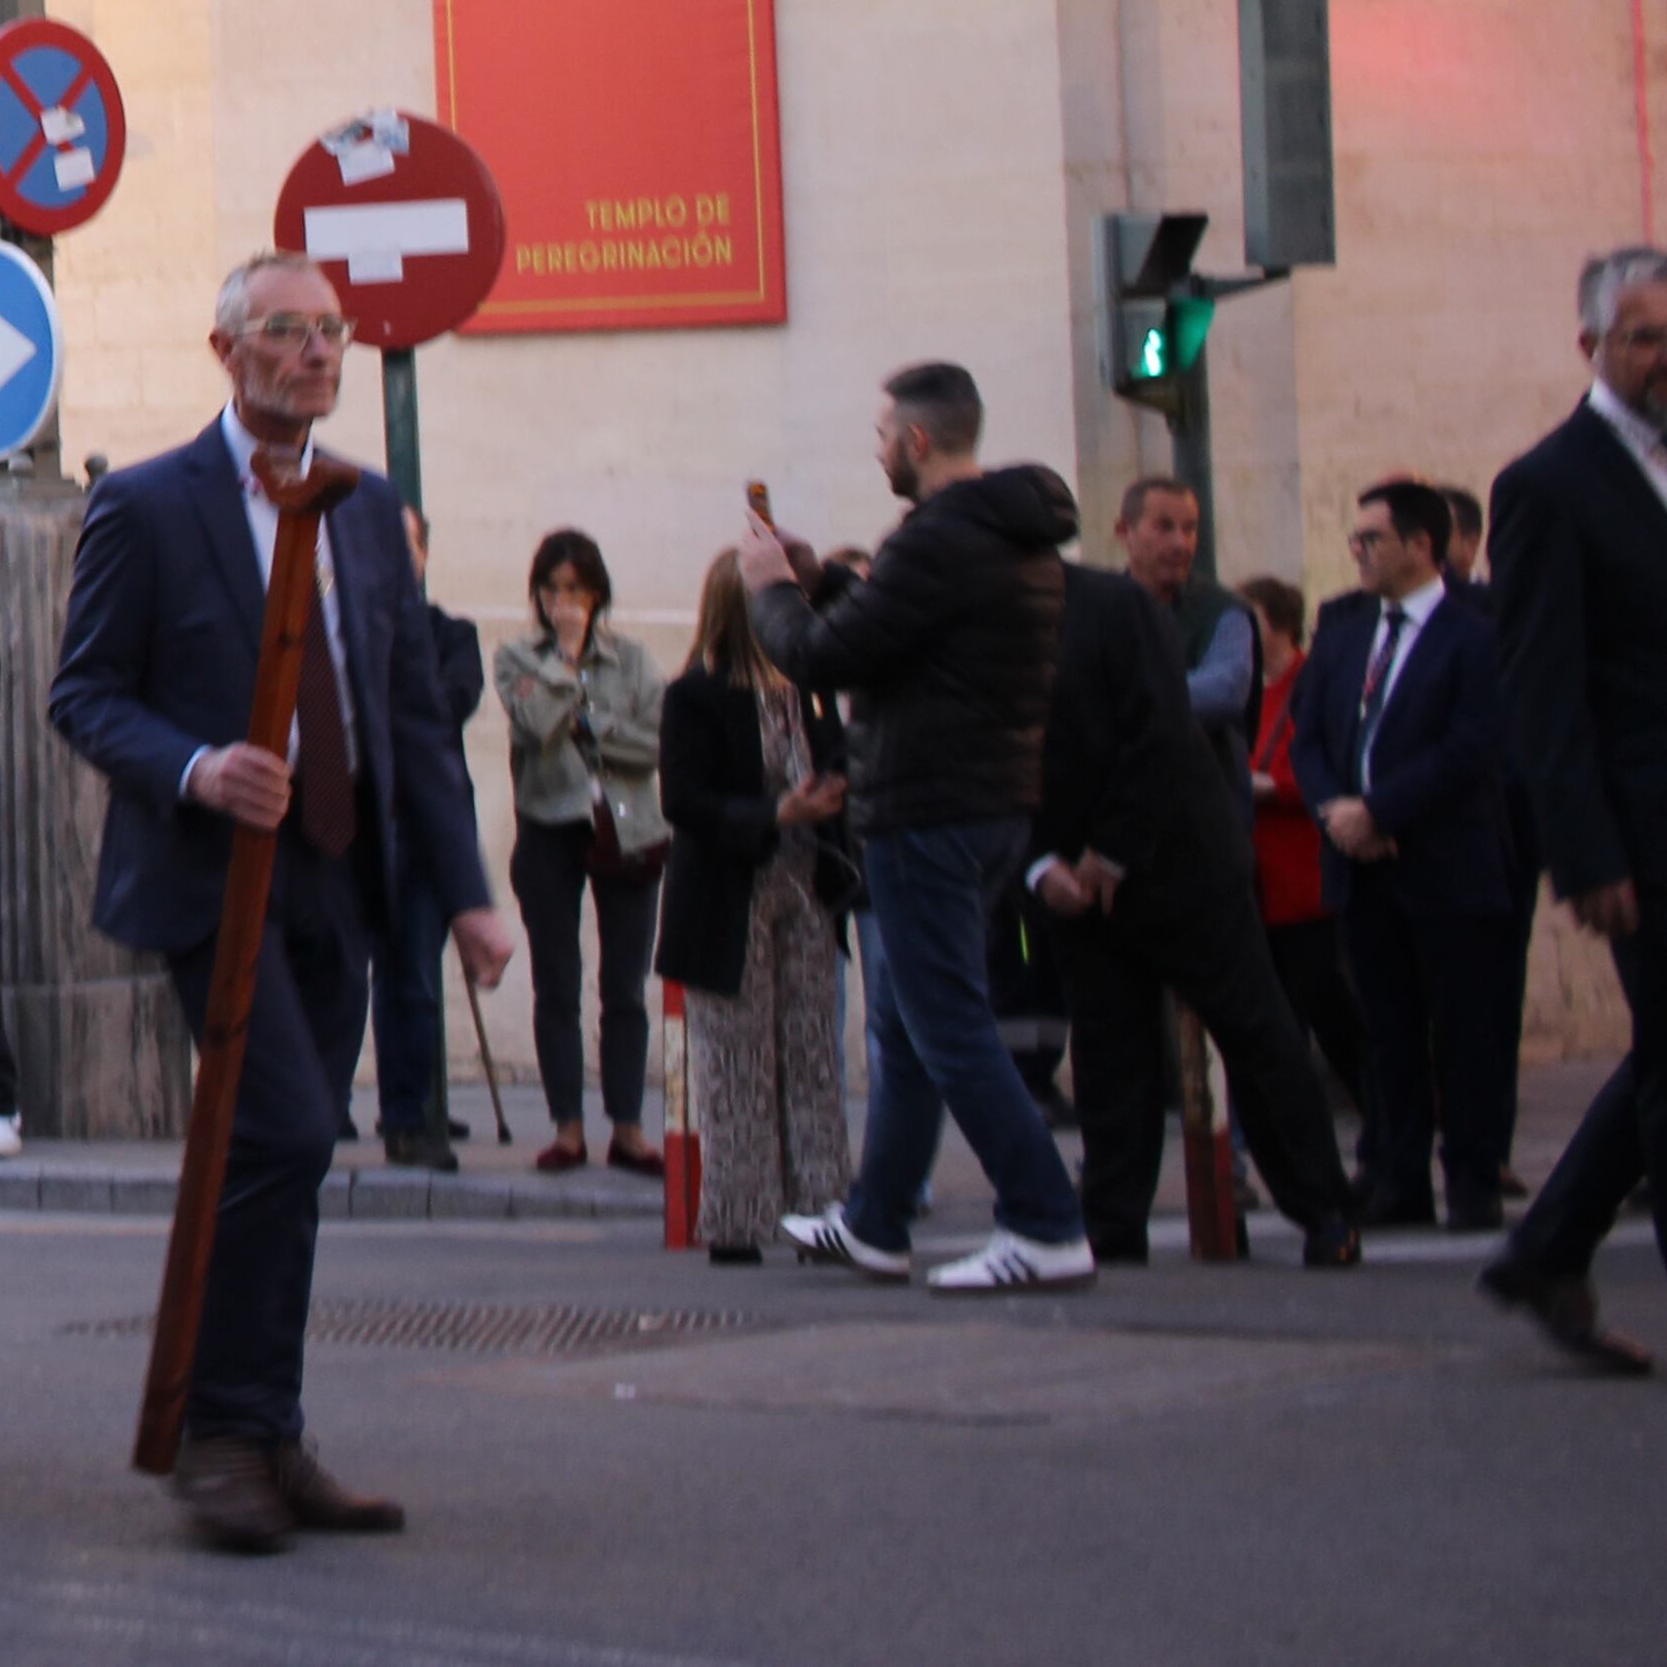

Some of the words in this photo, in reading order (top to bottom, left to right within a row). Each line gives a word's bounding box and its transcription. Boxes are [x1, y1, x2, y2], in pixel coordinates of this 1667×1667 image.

[586, 195, 687, 230] TEMPLO
[695, 191, 730, 226] DE
[517, 230, 733, 275] PEREGRINACIÓN
